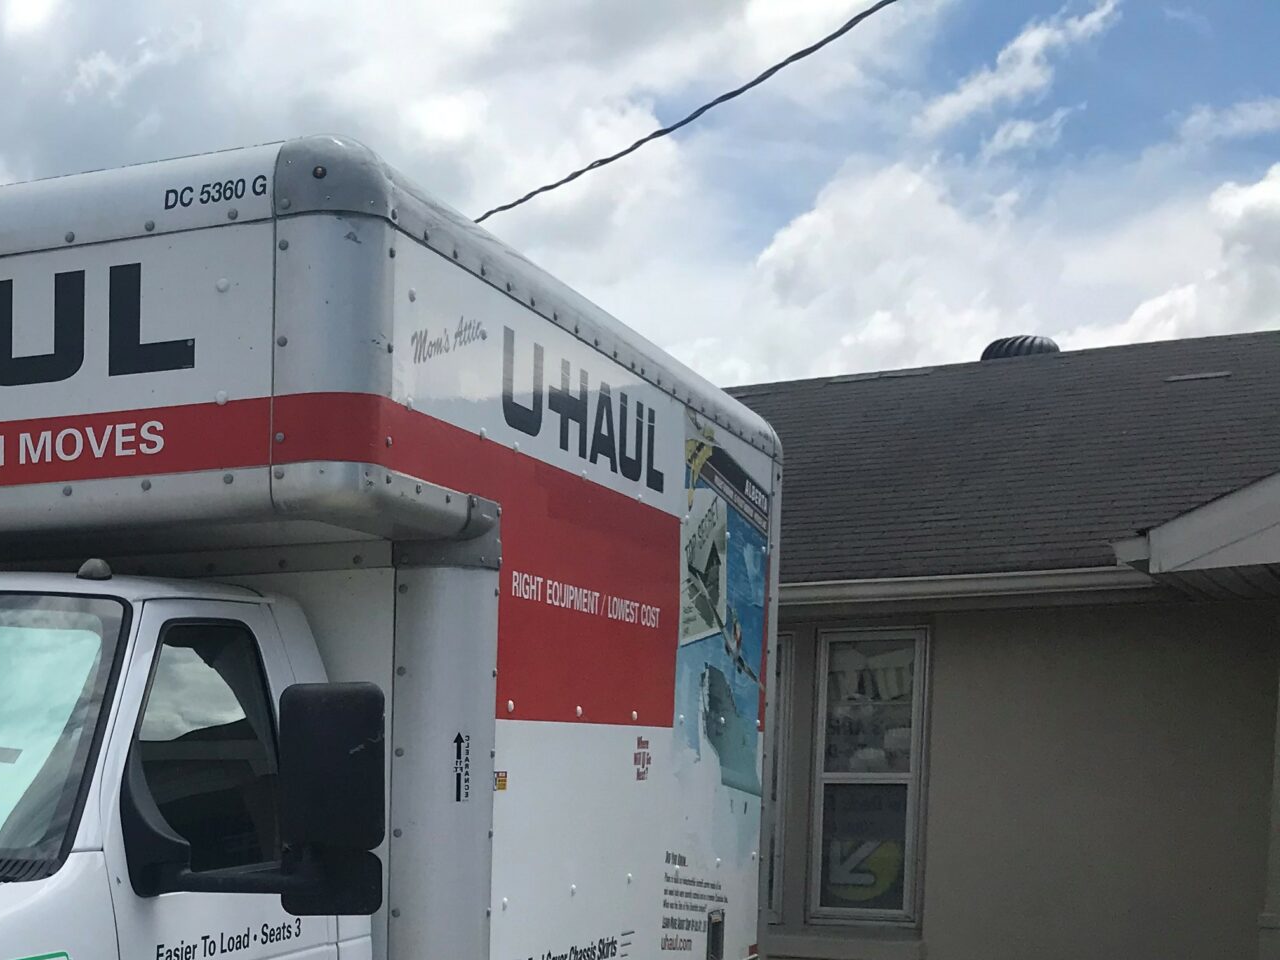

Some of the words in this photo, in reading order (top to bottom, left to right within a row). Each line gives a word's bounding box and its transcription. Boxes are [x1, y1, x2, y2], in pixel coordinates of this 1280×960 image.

[164, 186, 194, 210] DC
[199, 178, 246, 205] 5360
[252, 174, 267, 196] G
[410, 327, 450, 364] Mom's
[502, 325, 664, 494] U-HAUL
[18, 420, 165, 469] MOVES
[511, 570, 544, 602] RIGHT
[546, 579, 600, 615] EQUIPMENT
[607, 595, 640, 624] LOWEST
[640, 604, 661, 629] COST
[201, 934, 216, 957] To
[220, 927, 250, 954] Load
[261, 921, 292, 945] Seats
[294, 917, 301, 937] 3
